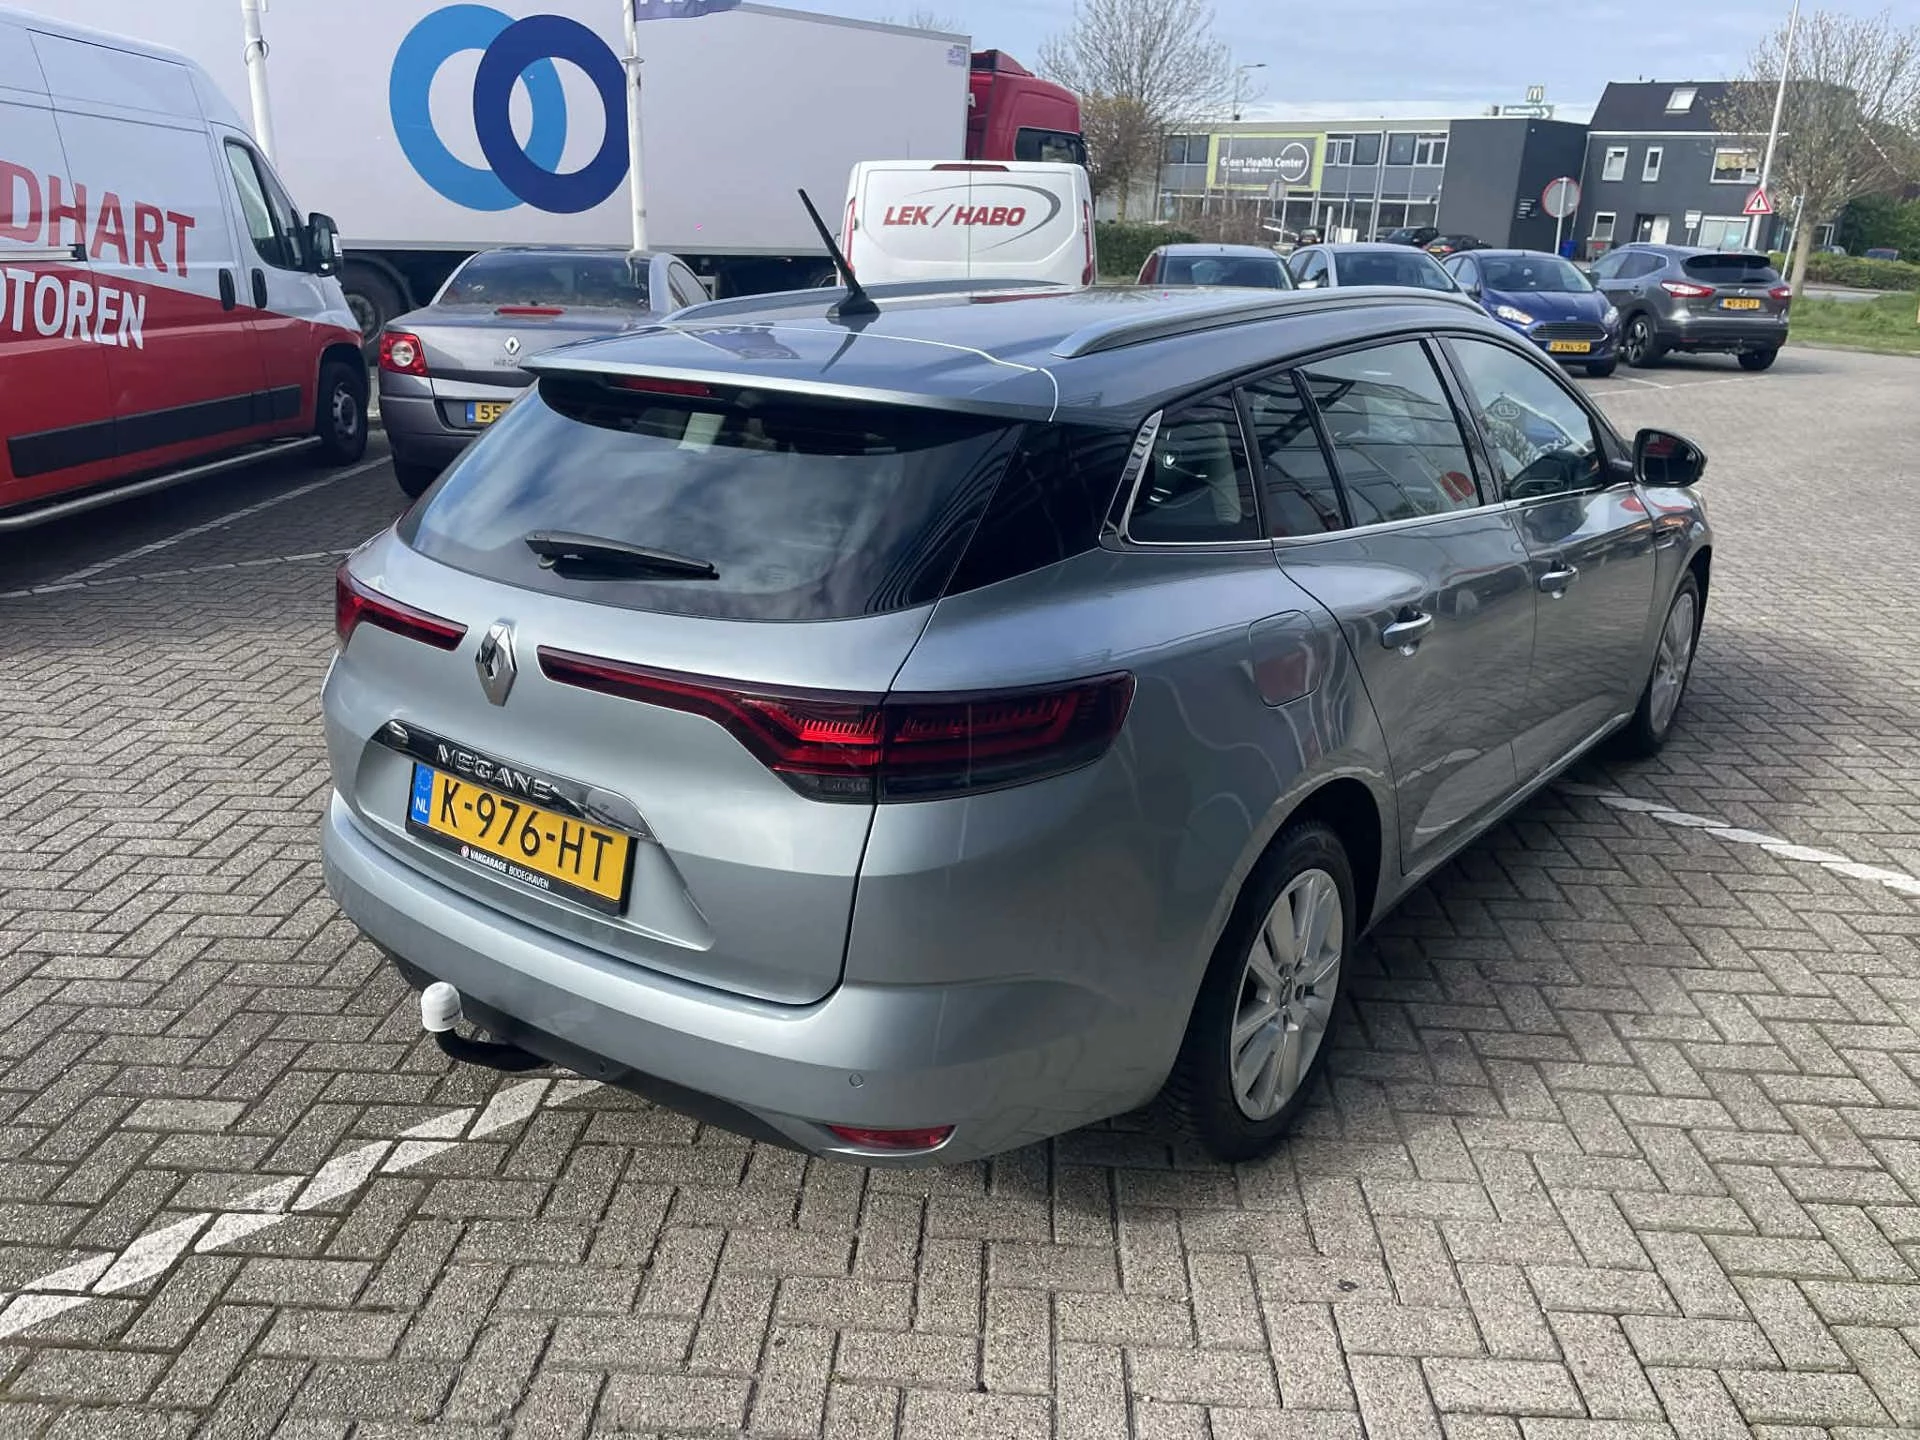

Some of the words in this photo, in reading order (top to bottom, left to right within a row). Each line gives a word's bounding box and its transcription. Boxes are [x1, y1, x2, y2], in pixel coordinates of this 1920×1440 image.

[1246, 157, 1273, 168] Health
[1275, 157, 1304, 168] Center
[883, 206, 934, 226] LEK
[953, 206, 1026, 226] HABO
[0, 268, 146, 350] TOREN
[437, 743, 555, 799] MEGANE
[415, 796, 429, 815] NL
[440, 778, 613, 881] K-976-HT
[470, 849, 507, 872] VAKGARAGE
[509, 866, 549, 889] BODEGRAVEN
